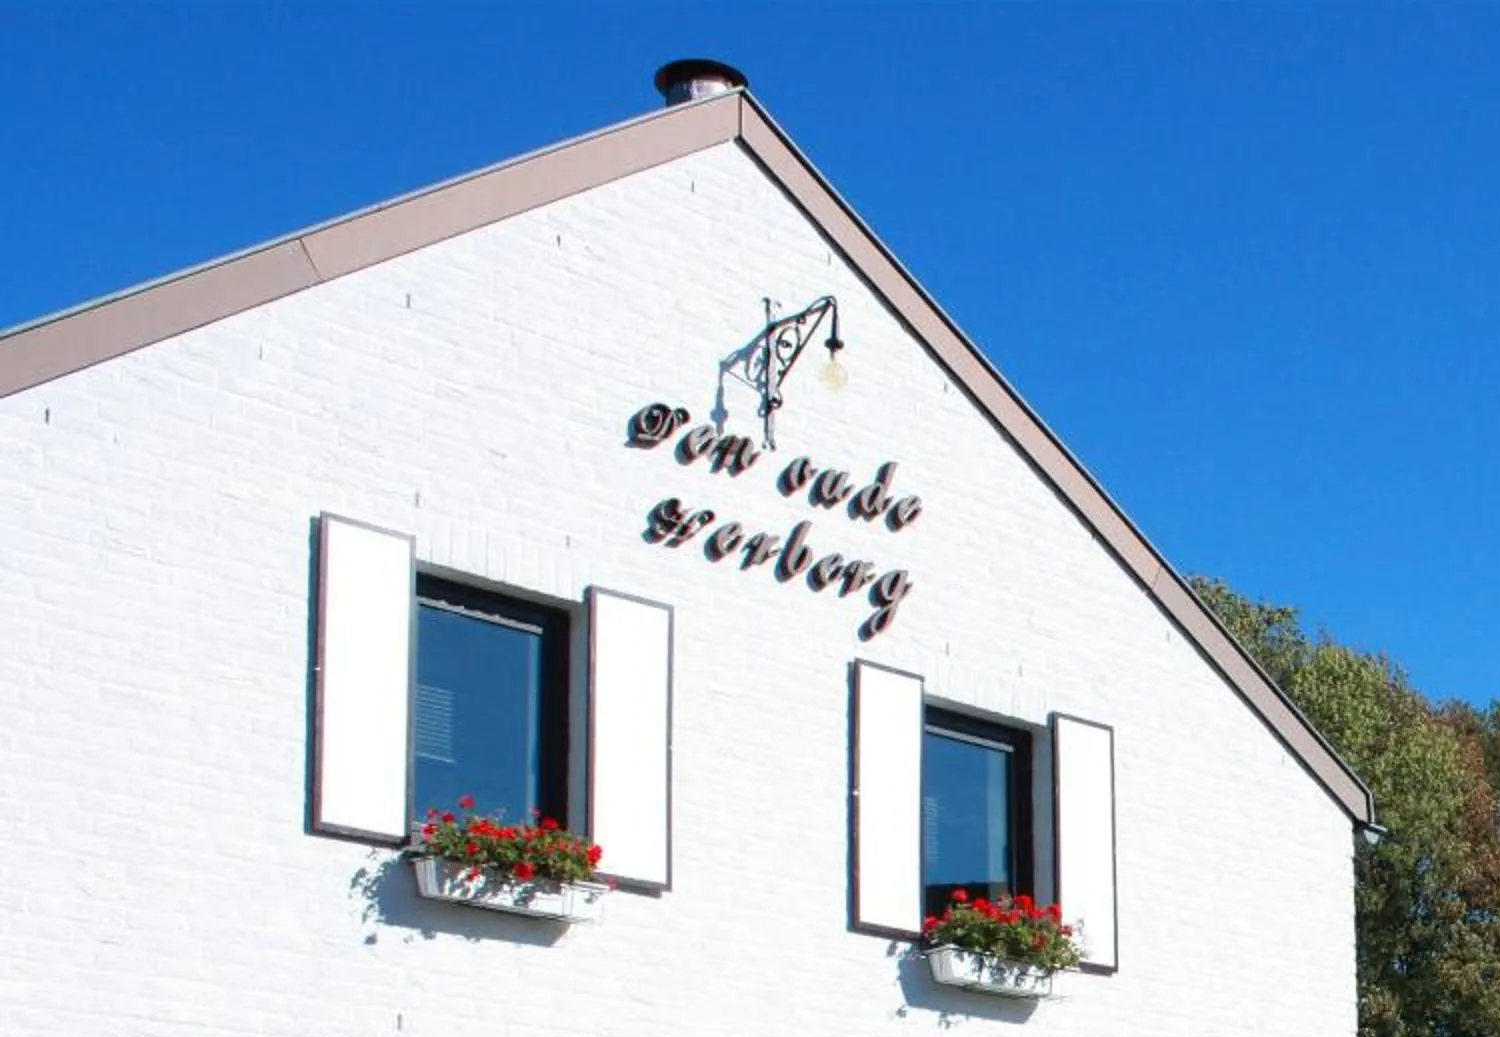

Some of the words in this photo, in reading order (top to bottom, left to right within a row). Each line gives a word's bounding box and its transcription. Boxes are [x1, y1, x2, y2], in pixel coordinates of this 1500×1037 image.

[624, 402, 760, 478] Den
[776, 456, 922, 533] oude
[641, 497, 912, 642] Herberg
